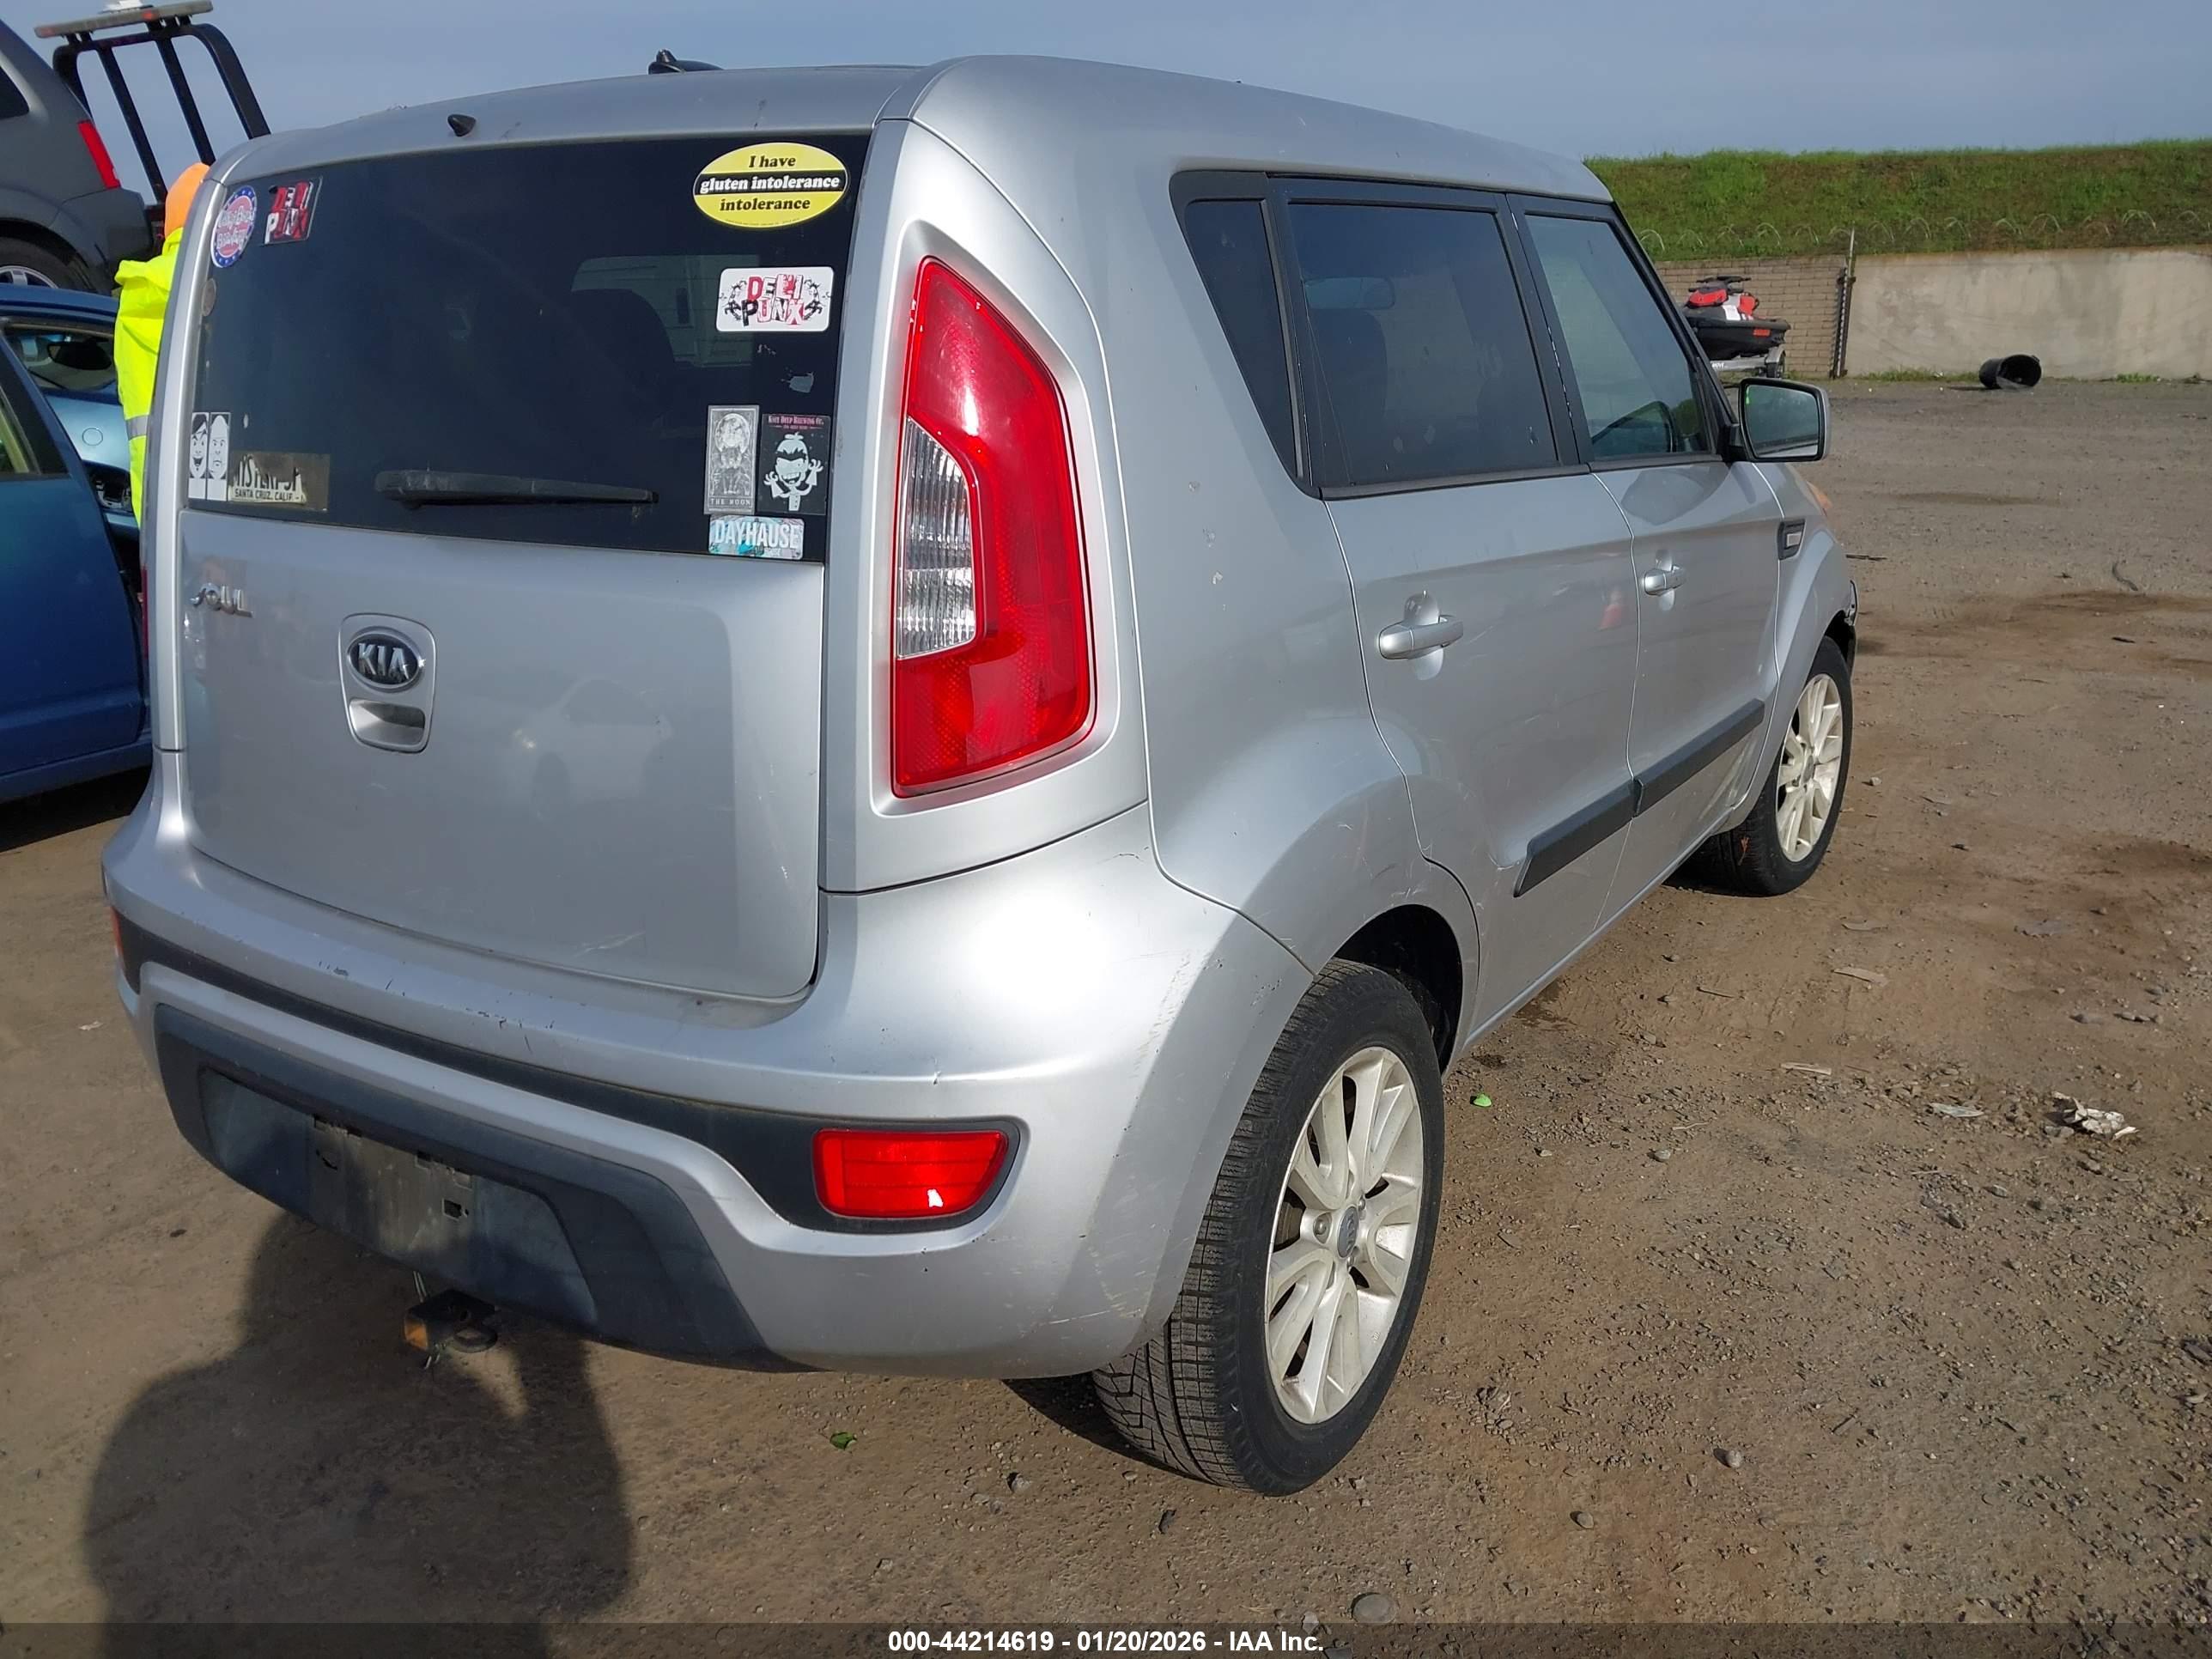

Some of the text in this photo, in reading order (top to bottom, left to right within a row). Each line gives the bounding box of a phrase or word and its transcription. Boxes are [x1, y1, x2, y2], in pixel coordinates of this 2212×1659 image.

[749, 155, 796, 167] I have
[700, 174, 841, 194] gluten intolerance
[719, 198, 811, 211] intolerance
[746, 273, 805, 302] DELI
[740, 298, 805, 327] PUNX
[234, 488, 254, 498] SANTA
[714, 520, 801, 550] DAYHAUSE
[357, 643, 410, 679] KIA
